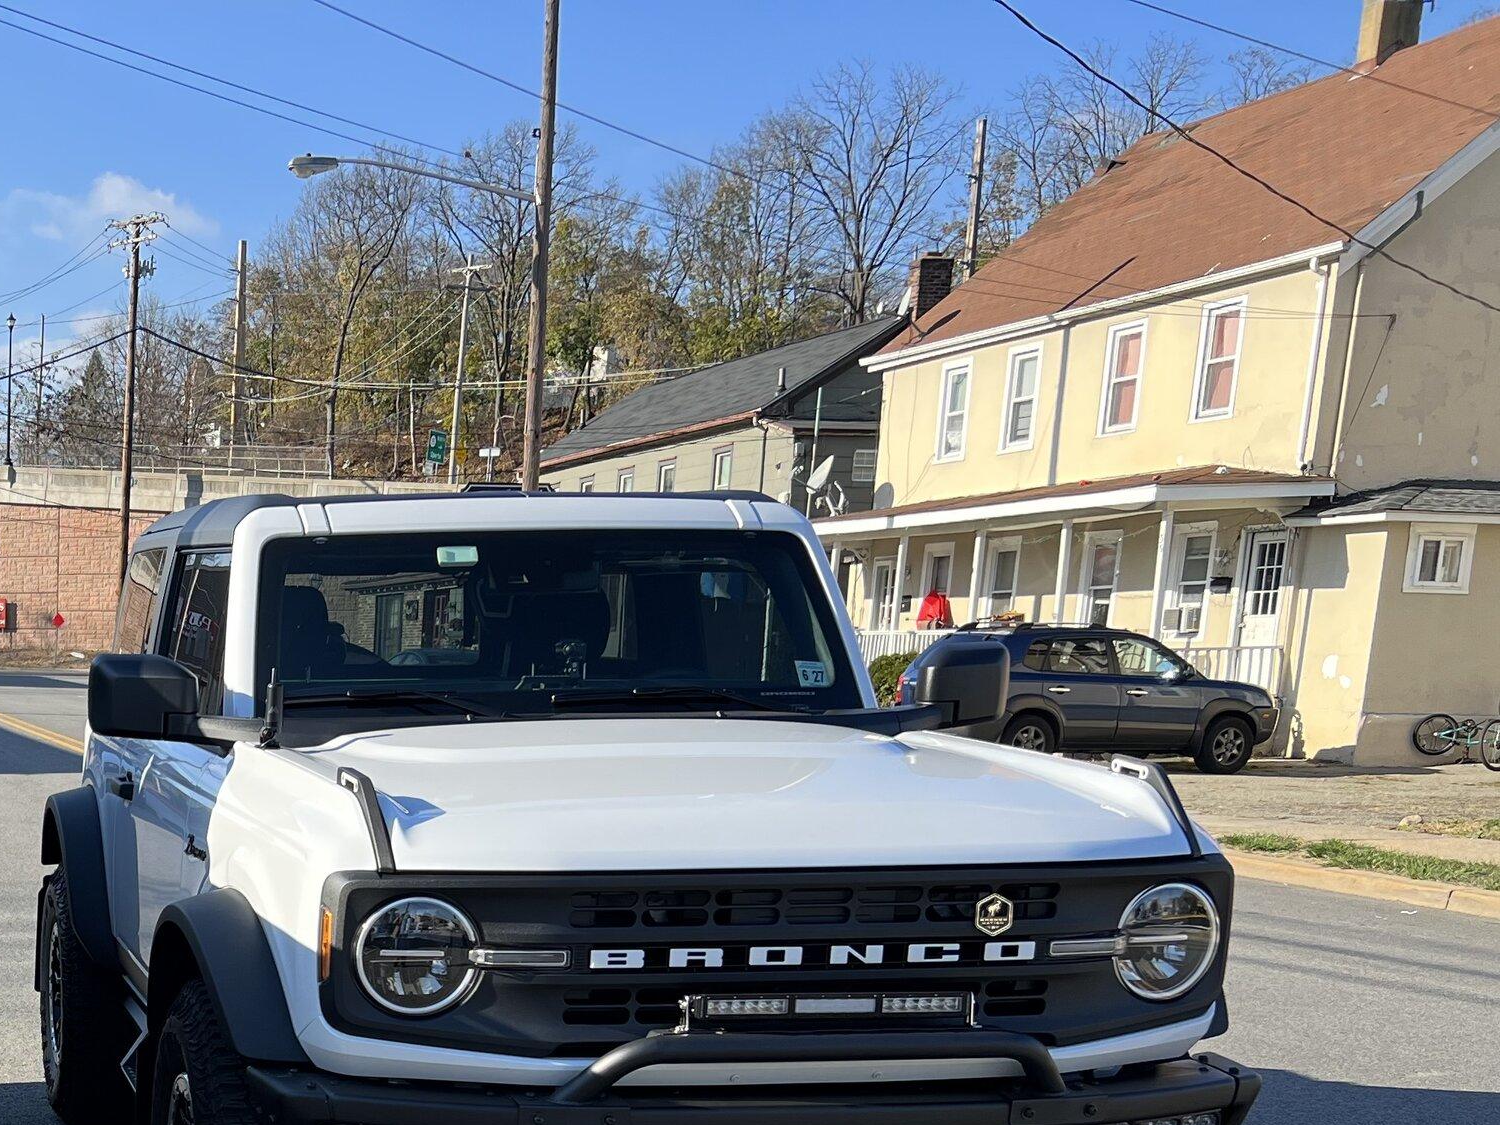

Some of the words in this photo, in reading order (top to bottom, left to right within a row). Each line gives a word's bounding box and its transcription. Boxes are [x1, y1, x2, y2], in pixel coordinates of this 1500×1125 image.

[802, 669, 809, 681] 6
[812, 670, 824, 683] 27
[589, 940, 1036, 969] BRONCO
